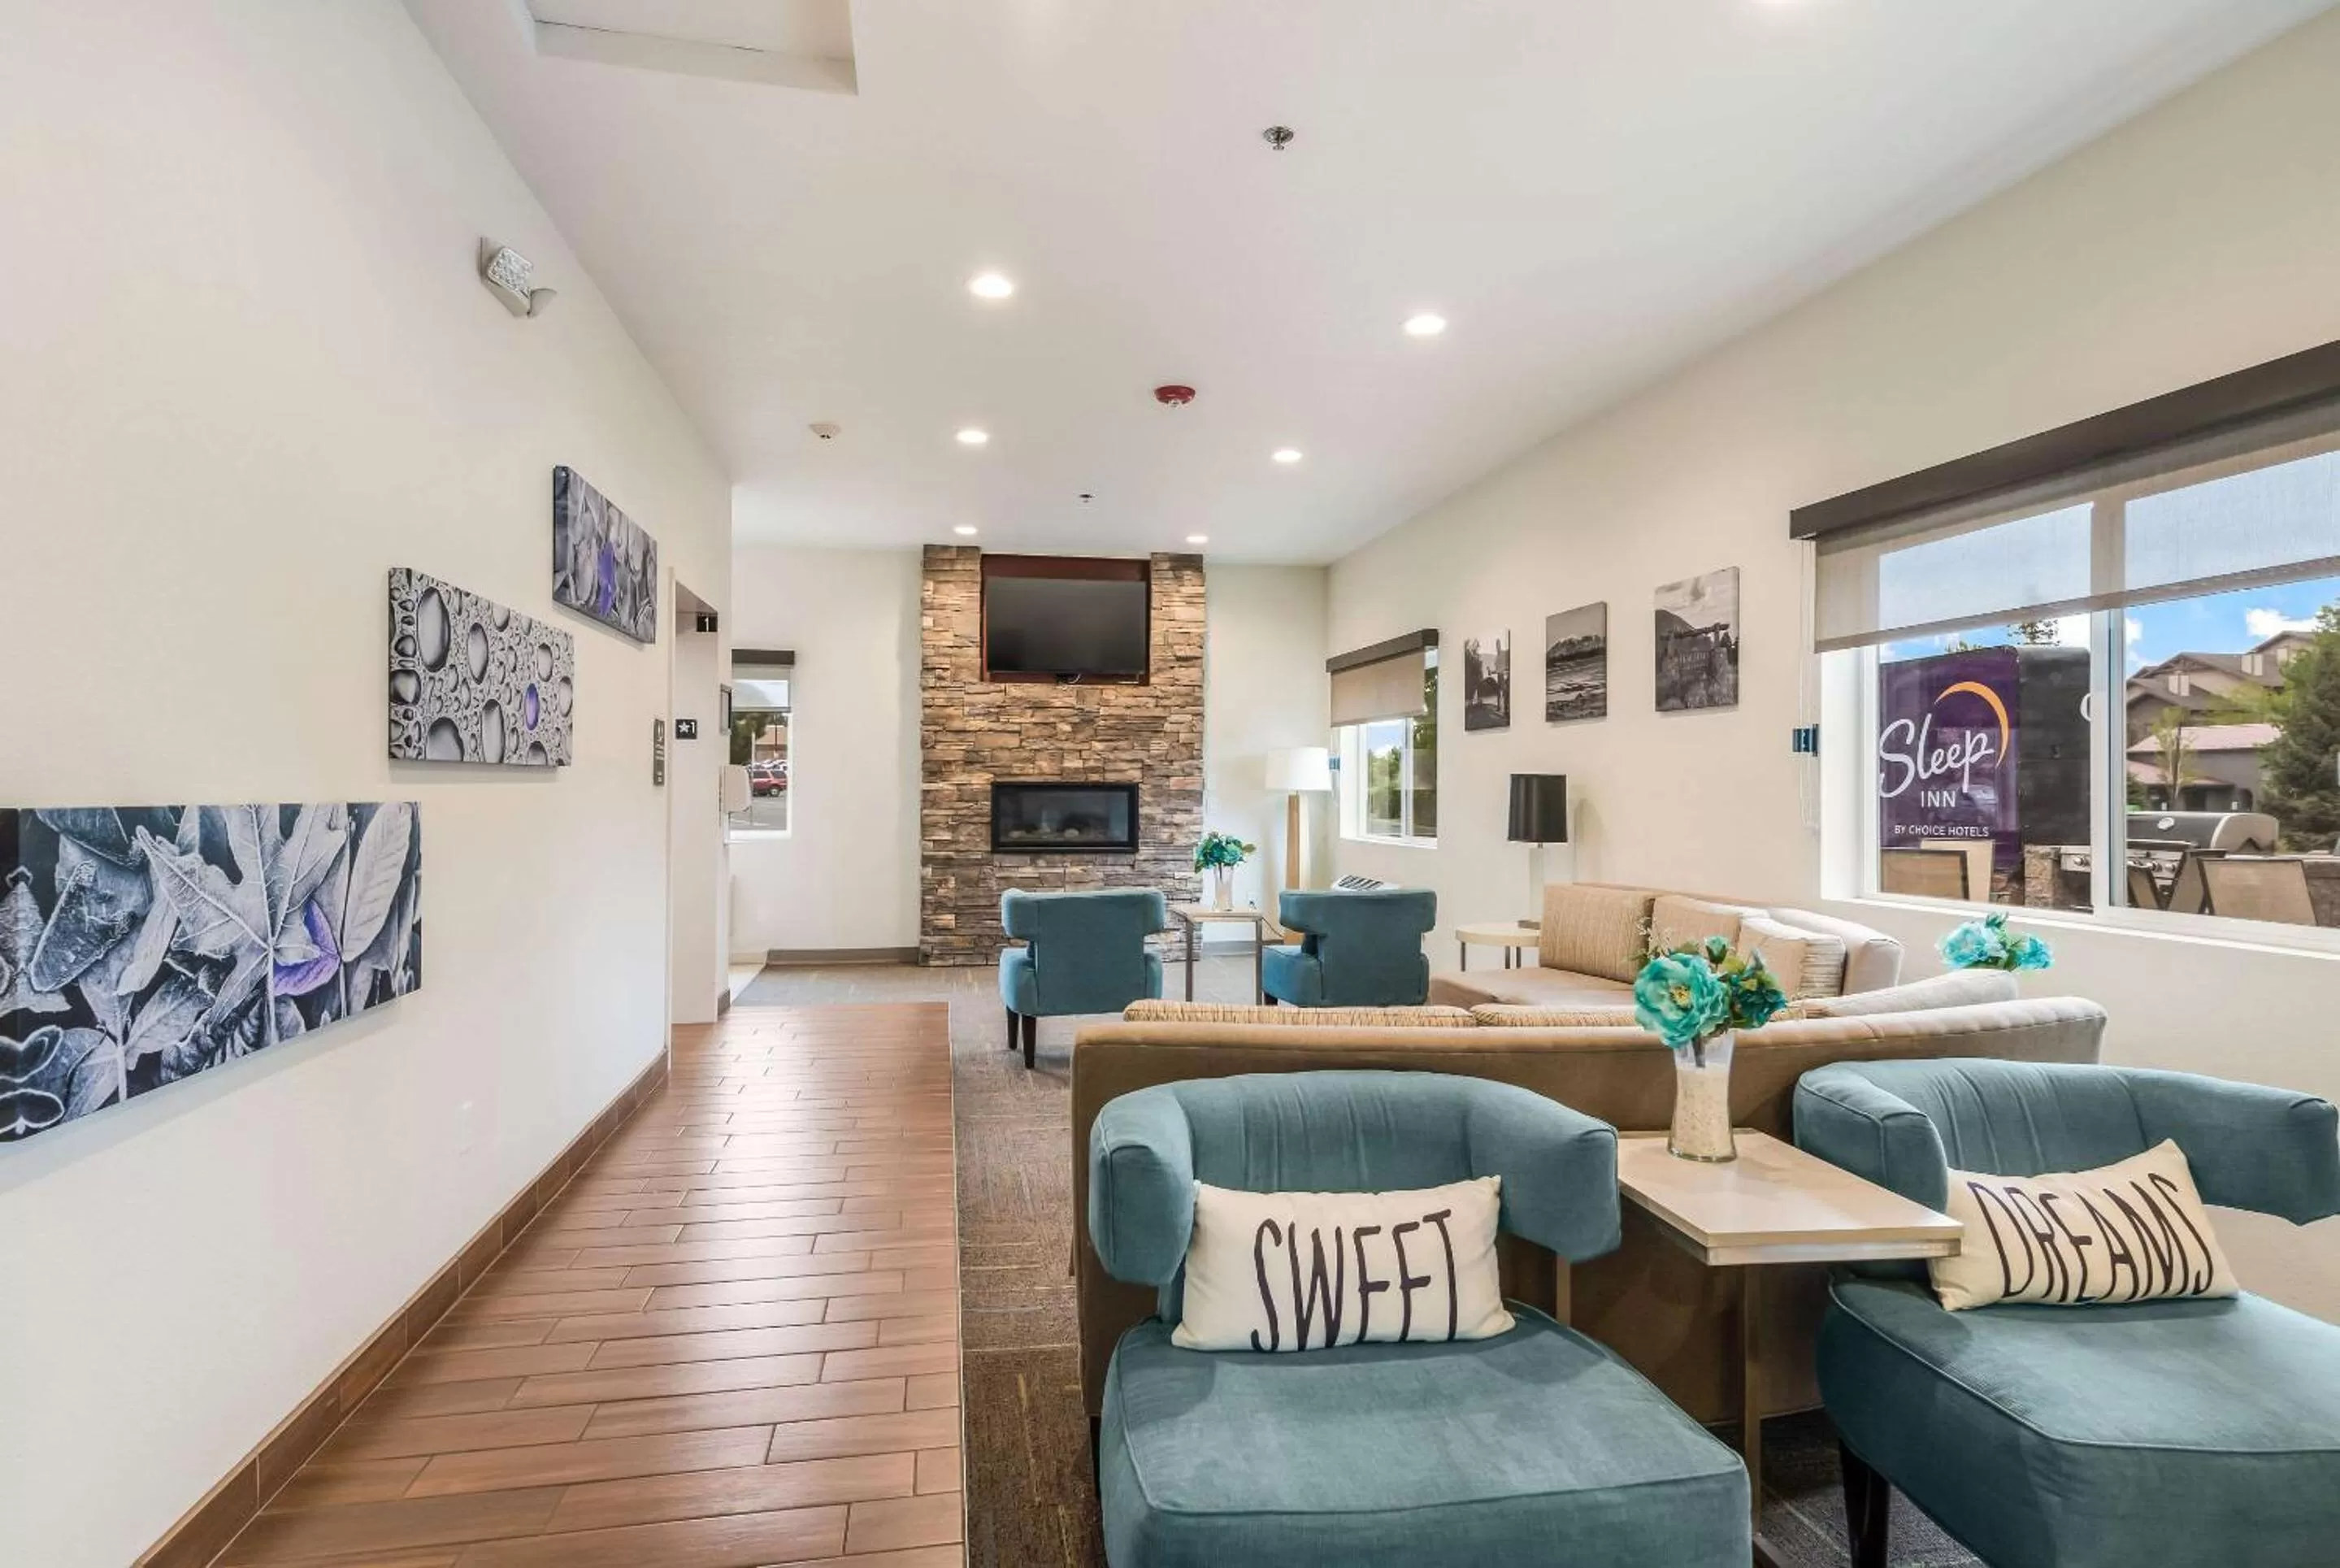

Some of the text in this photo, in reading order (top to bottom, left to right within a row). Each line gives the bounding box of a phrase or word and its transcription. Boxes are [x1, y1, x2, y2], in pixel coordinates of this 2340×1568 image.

[704, 617, 710, 632] 1
[1879, 713, 1995, 797] Sleep
[1921, 790, 1957, 808] INN
[1894, 824, 1990, 837] BY CHOICE HOTELS
[1966, 1172, 2214, 1303] DREAMS
